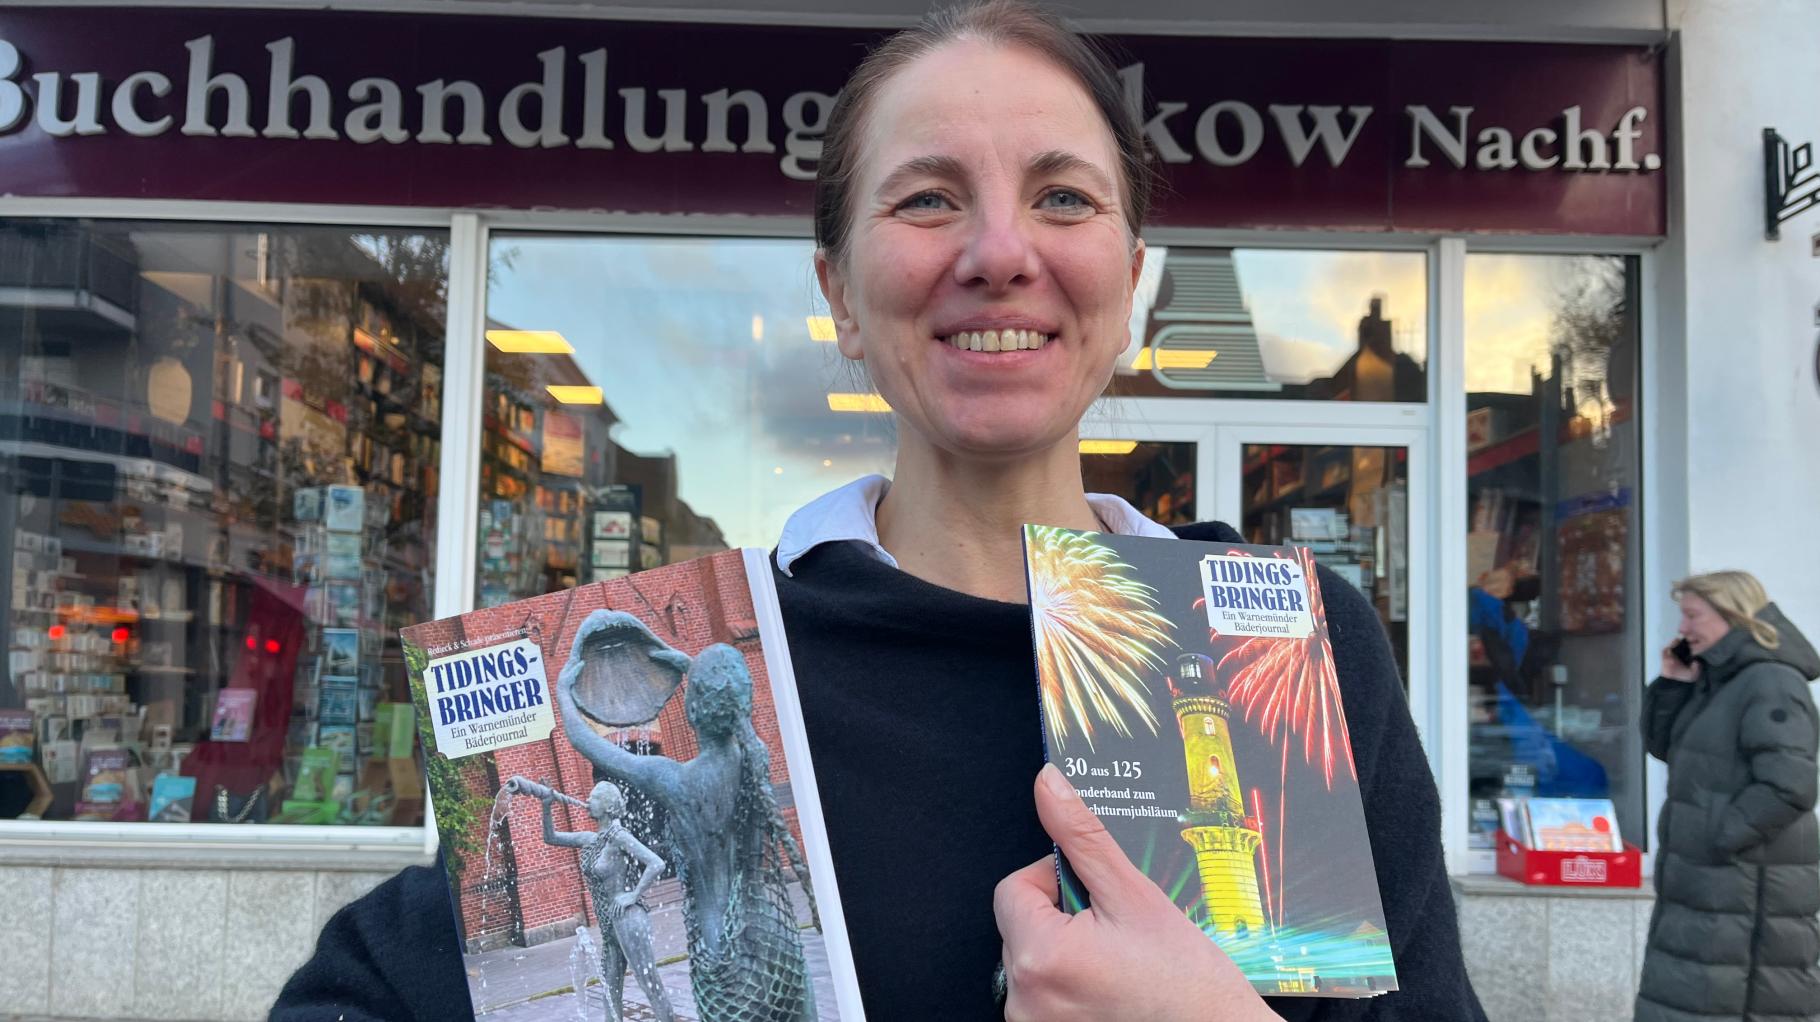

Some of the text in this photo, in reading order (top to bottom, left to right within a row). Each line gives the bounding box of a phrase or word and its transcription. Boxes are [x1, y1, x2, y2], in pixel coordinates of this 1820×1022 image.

[1117, 62, 1373, 168] kow
[1404, 105, 1662, 170] Nachf.
[1206, 560, 1300, 585] TIDINGS-
[1211, 586, 1304, 611] BRINGER
[1222, 611, 1298, 623] Ein Warnemünder
[1234, 622, 1290, 634] Bäderjournal
[431, 646, 538, 693] TIDINGS-
[437, 678, 543, 726] BRINGER
[451, 712, 537, 739] Ein Warnemünder
[465, 727, 528, 750] Bäderjournal
[1064, 757, 1087, 777] 30
[1090, 767, 1109, 777] aus
[1112, 761, 1142, 779] 125
[1074, 787, 1155, 800] onderband zum
[1089, 804, 1178, 819] chtturmjubiläum
